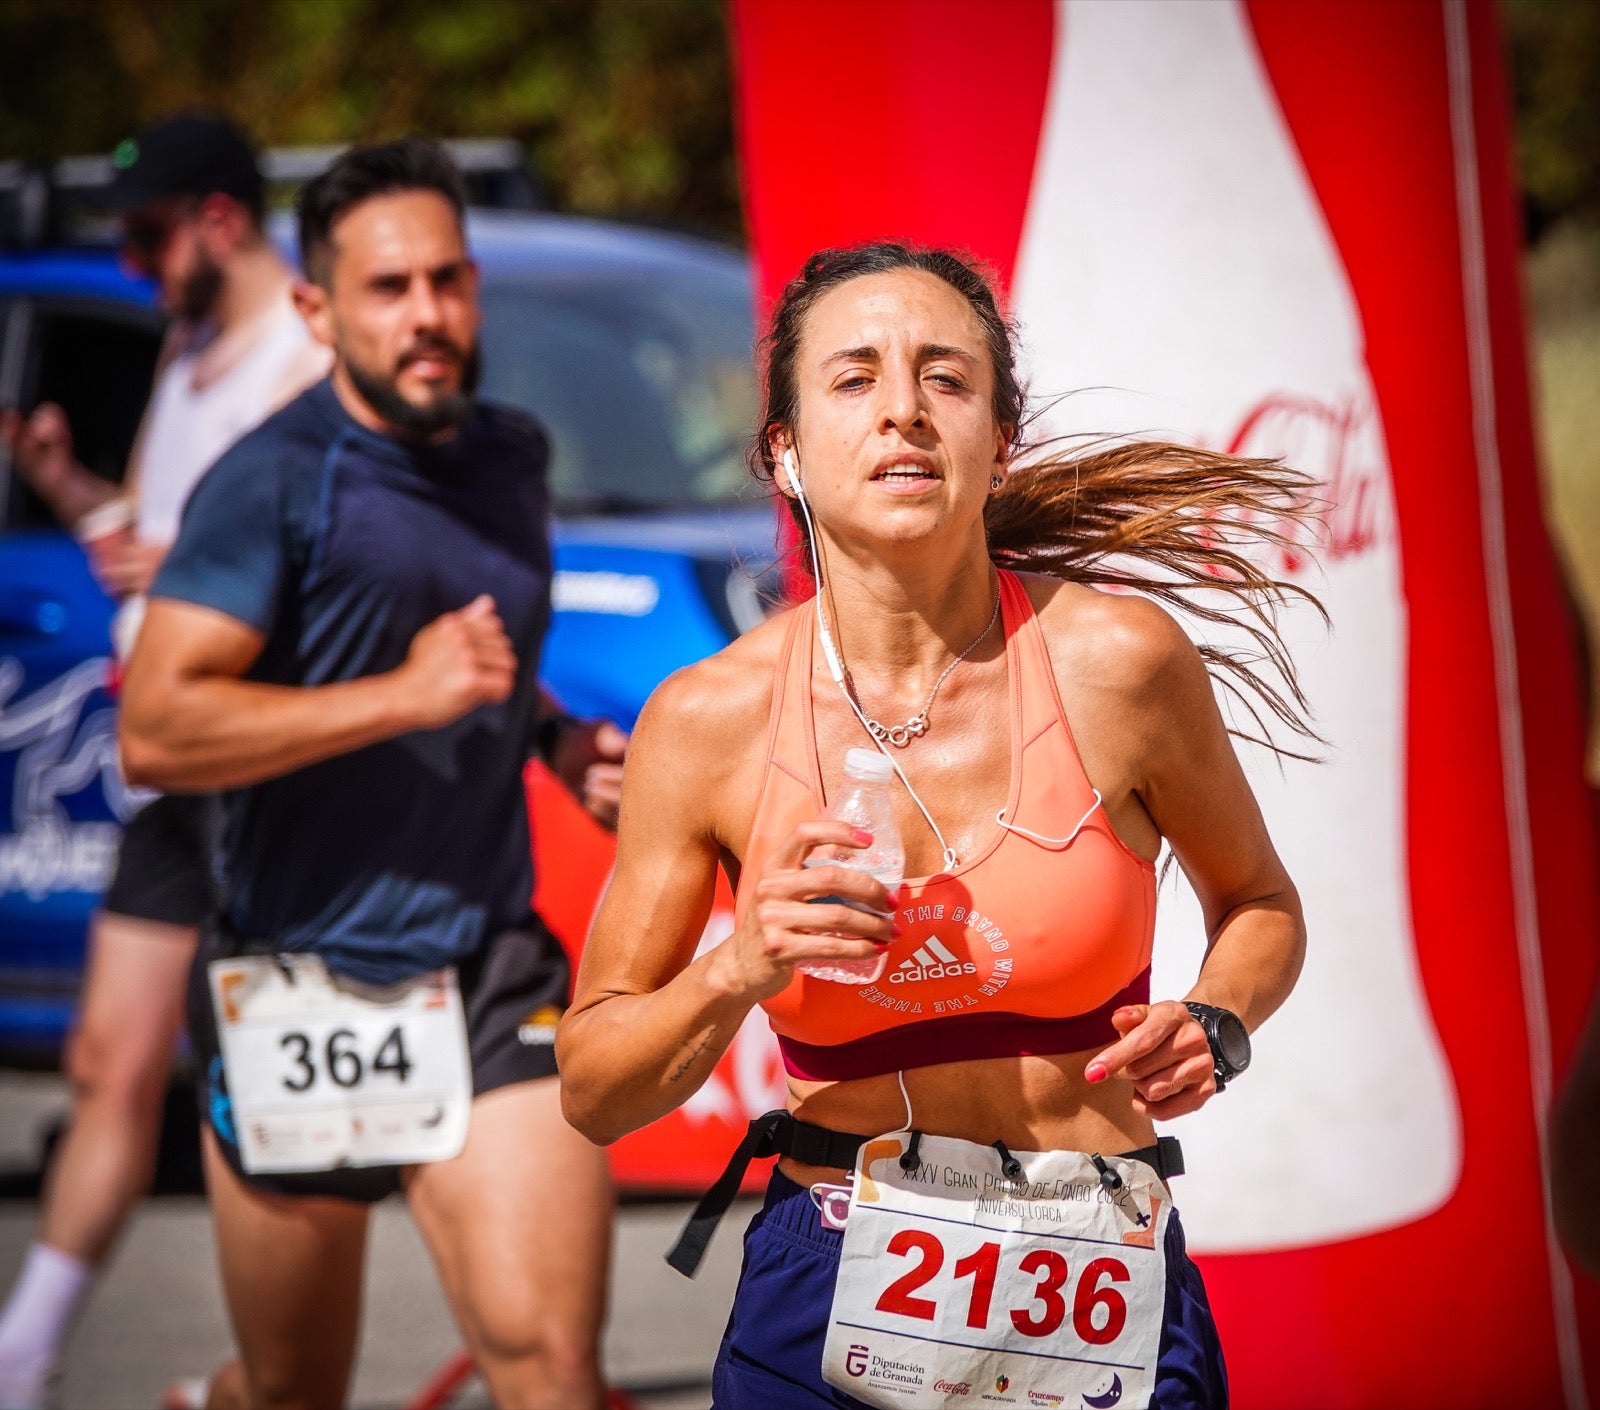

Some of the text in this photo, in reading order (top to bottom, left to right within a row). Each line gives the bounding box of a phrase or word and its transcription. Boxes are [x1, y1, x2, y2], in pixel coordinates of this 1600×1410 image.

[858, 904, 1013, 1013] THE BRAND WITH THE THREE
[888, 961, 977, 984] adidas
[279, 1025, 415, 1093] 364
[943, 1166, 978, 1189] GRAN
[1052, 1180, 1091, 1203] FONDO
[974, 1193, 1062, 1222] UNIVERSO LORCA
[875, 1229, 1131, 1346] 2136
[869, 1367, 923, 1385] de Granada
[871, 1355, 925, 1374] Diputación
[1028, 1390, 1065, 1403] Cruzcampo
